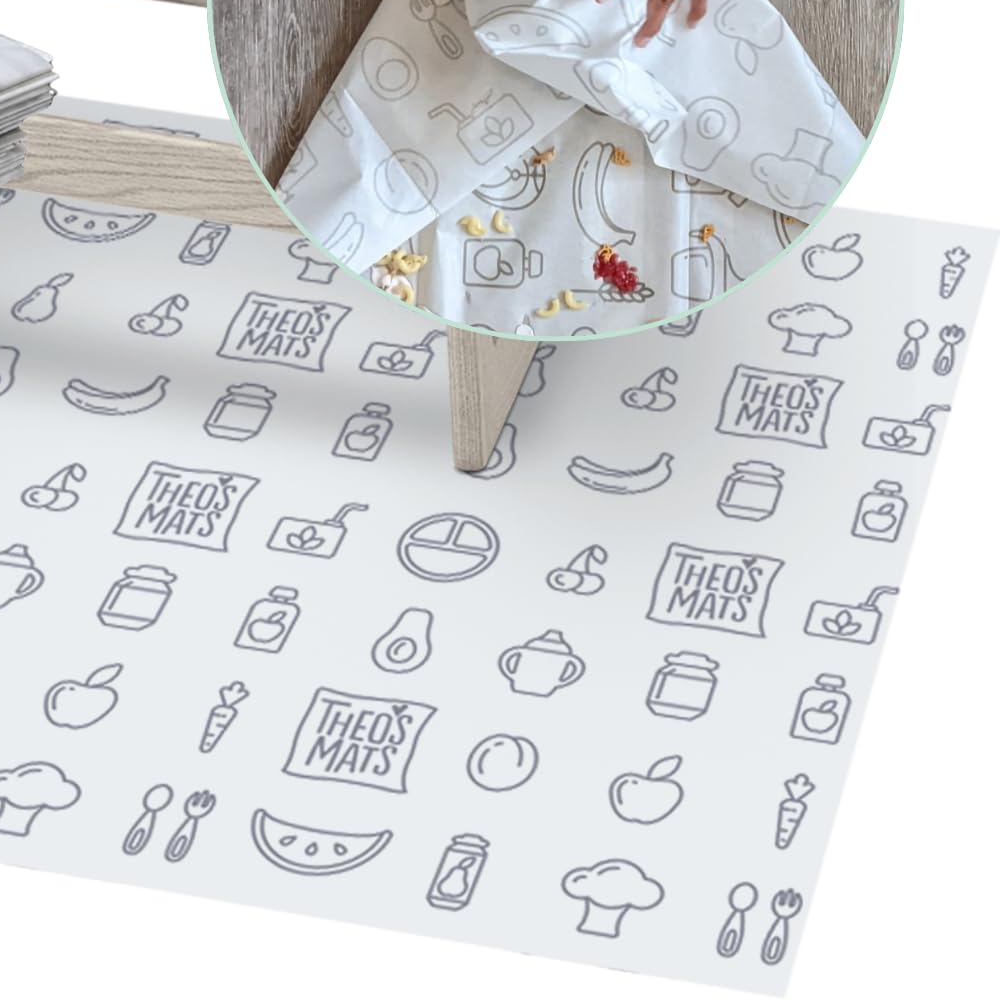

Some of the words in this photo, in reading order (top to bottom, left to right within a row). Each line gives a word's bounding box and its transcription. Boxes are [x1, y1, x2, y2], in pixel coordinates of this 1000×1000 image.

[236, 328, 317, 359] MATS
[735, 402, 815, 435] MATS
[135, 501, 220, 537] MATS
[667, 586, 752, 622] MATS
[305, 737, 398, 776] MATS
